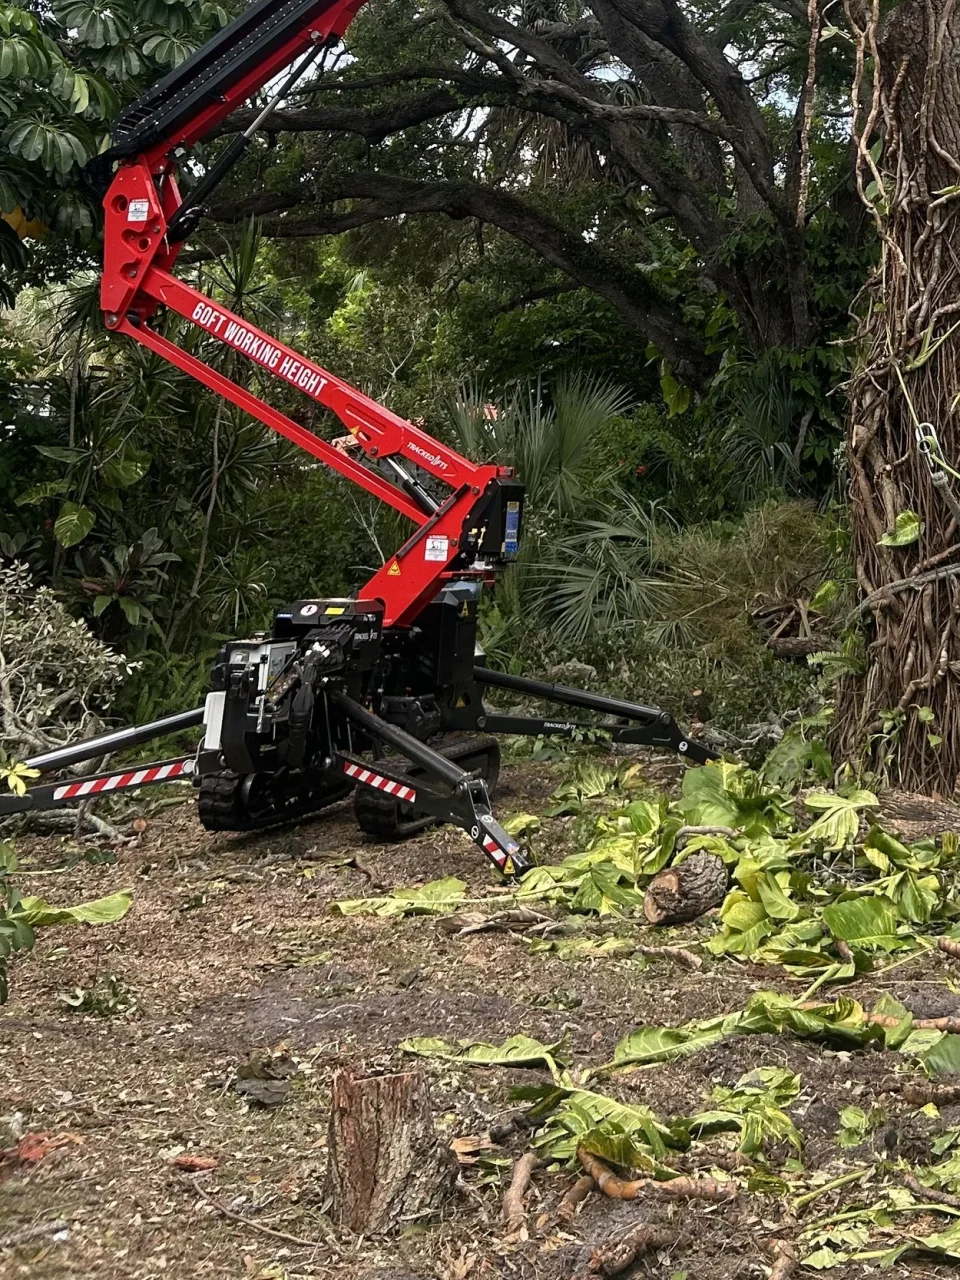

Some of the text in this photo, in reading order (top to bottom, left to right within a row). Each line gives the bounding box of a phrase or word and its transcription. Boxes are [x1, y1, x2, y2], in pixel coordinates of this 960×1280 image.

[192, 302, 328, 397] 60FT WORKING HEIGHT
